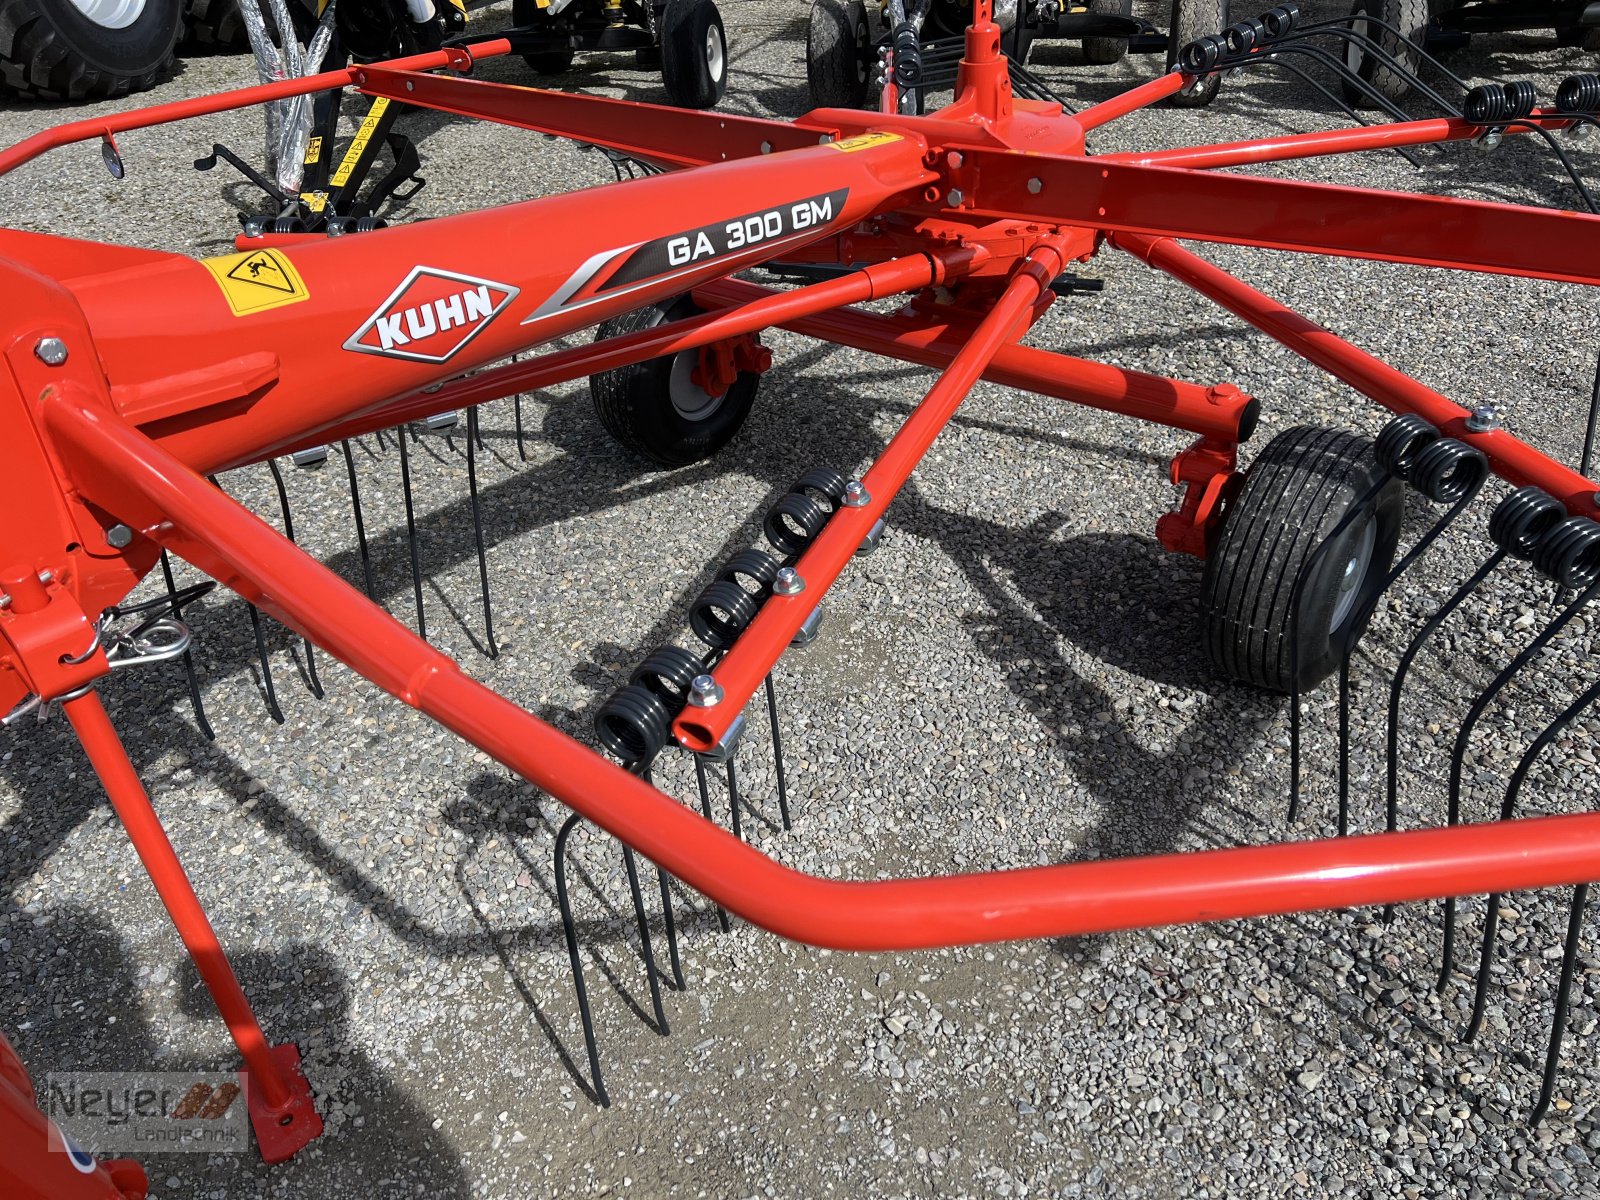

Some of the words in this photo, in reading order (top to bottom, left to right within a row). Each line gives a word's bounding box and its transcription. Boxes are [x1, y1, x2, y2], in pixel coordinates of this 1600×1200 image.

[667, 231, 715, 266] GA
[725, 210, 782, 249] 300
[791, 196, 832, 230] GM
[375, 285, 493, 350] KUHN
